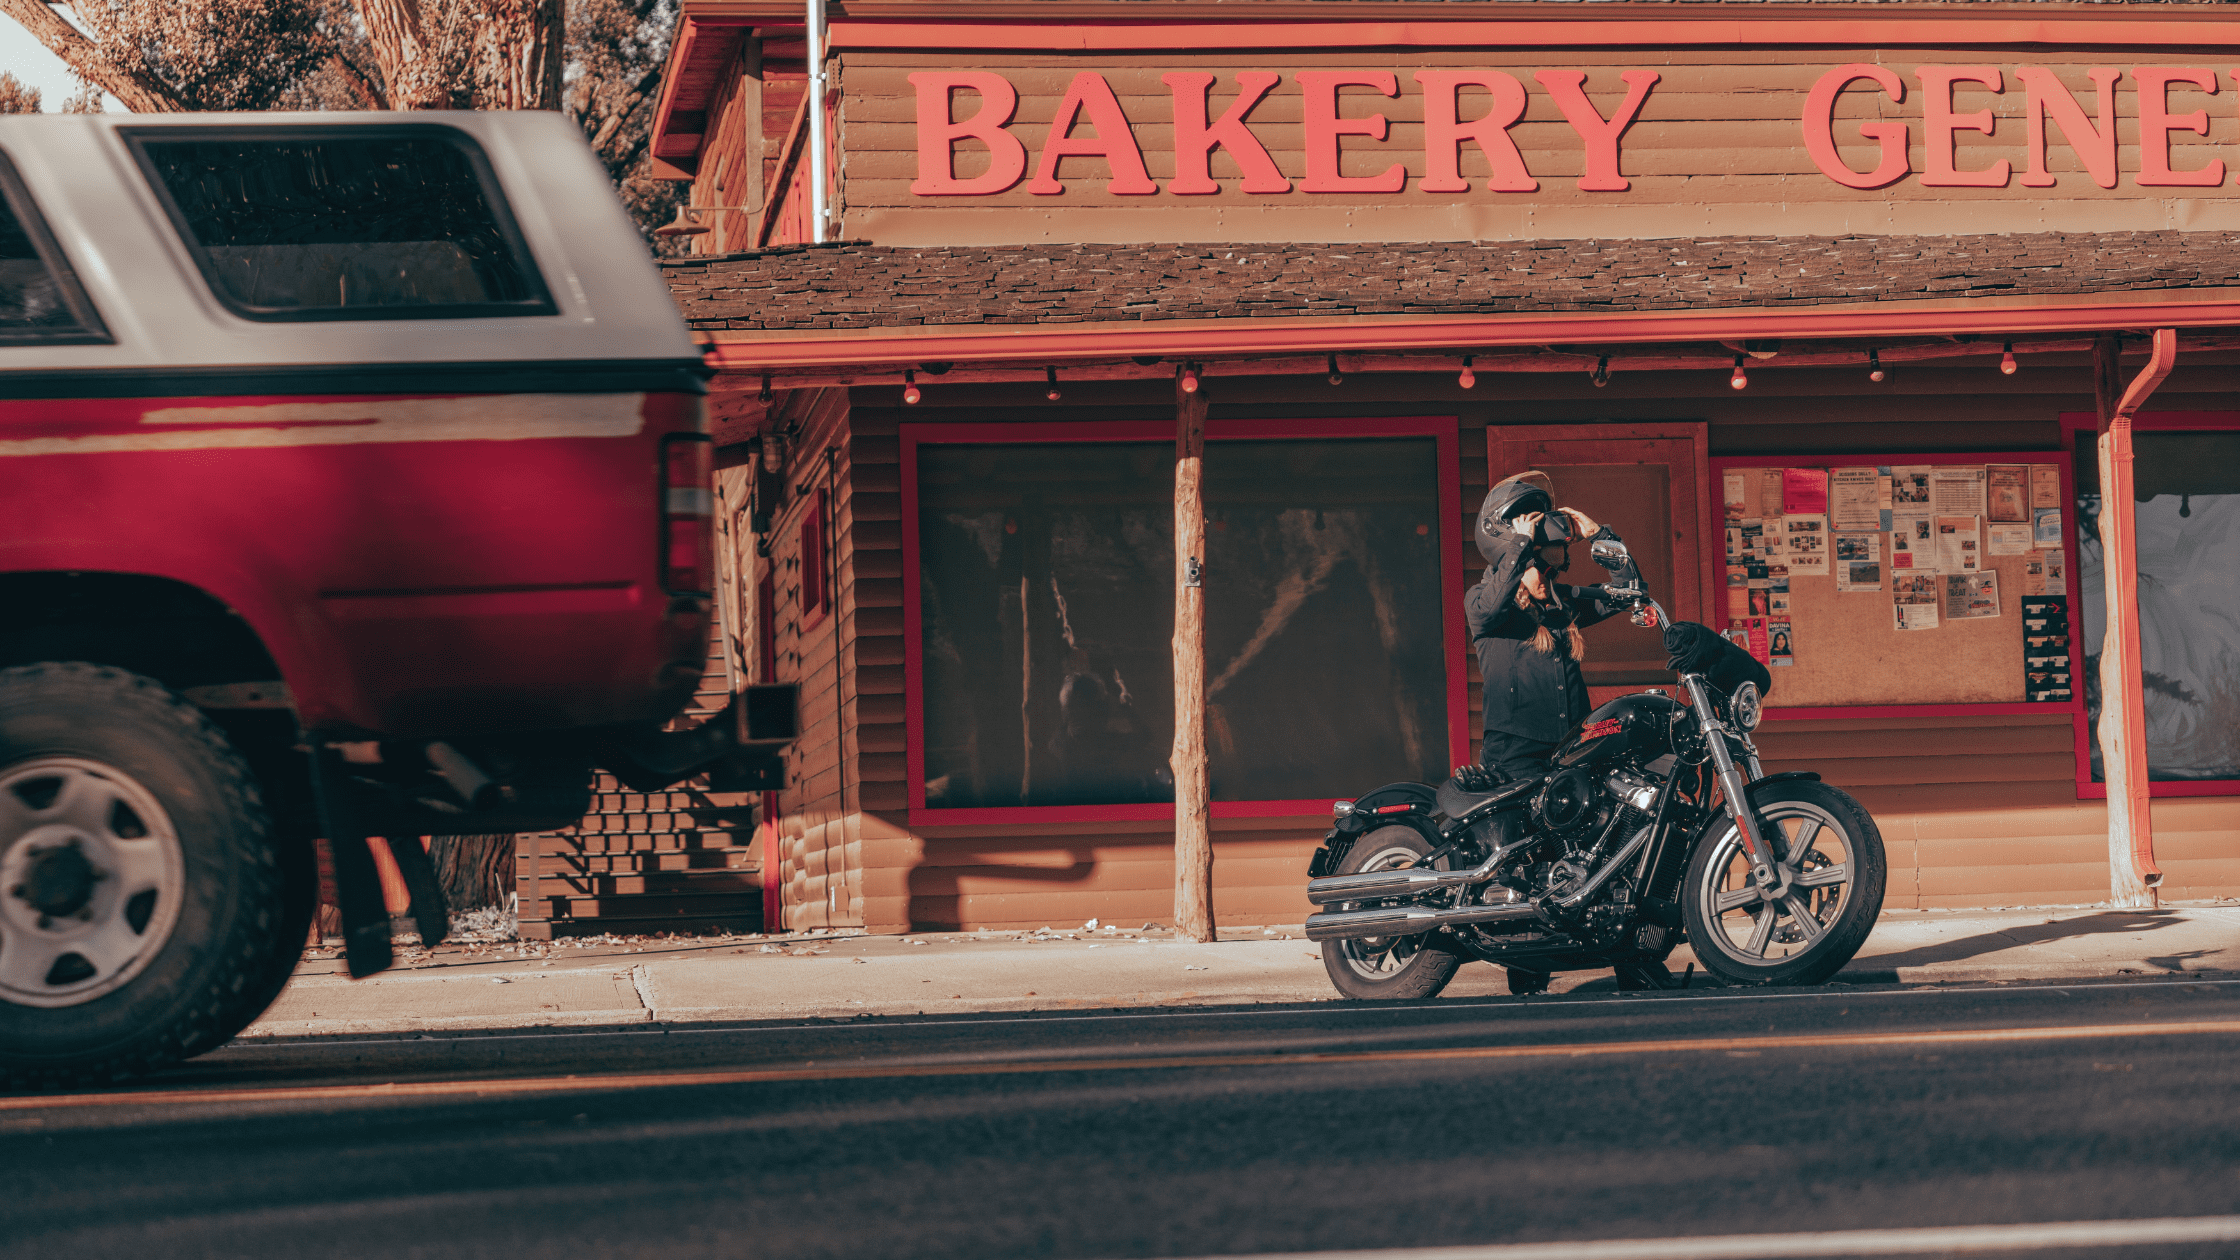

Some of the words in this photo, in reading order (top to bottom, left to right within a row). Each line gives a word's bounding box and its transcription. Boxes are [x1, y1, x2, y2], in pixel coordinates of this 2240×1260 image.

[908, 69, 1660, 195] BAKERY
[1802, 63, 2240, 189] GENE
[1948, 588, 1966, 597] TREAT
